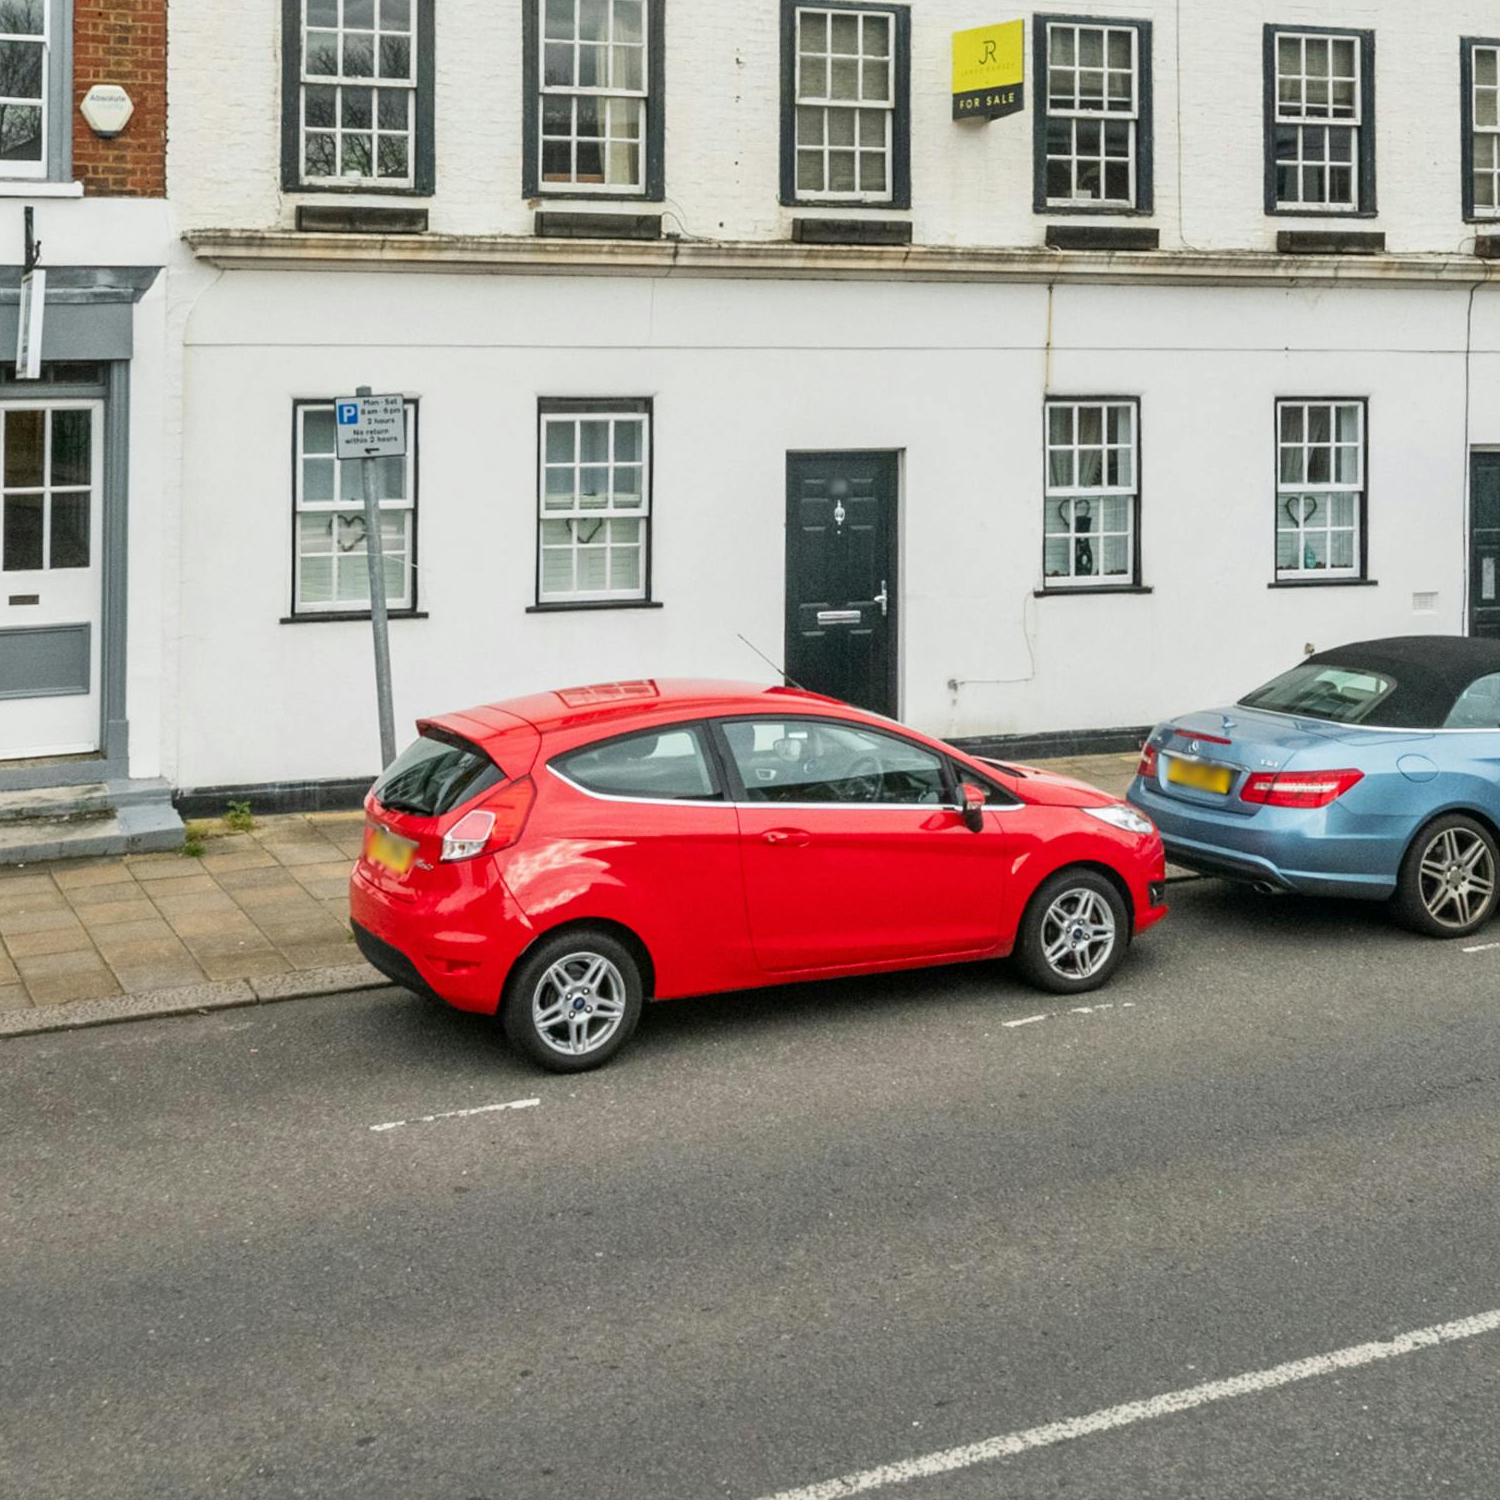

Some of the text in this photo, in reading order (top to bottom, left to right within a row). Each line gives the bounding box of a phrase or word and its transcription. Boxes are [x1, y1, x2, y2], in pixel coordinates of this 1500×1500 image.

[89, 94, 127, 102] Absolute
[959, 92, 1016, 109] FOR SALE
[343, 406, 356, 423] P
[345, 437, 368, 445] within
